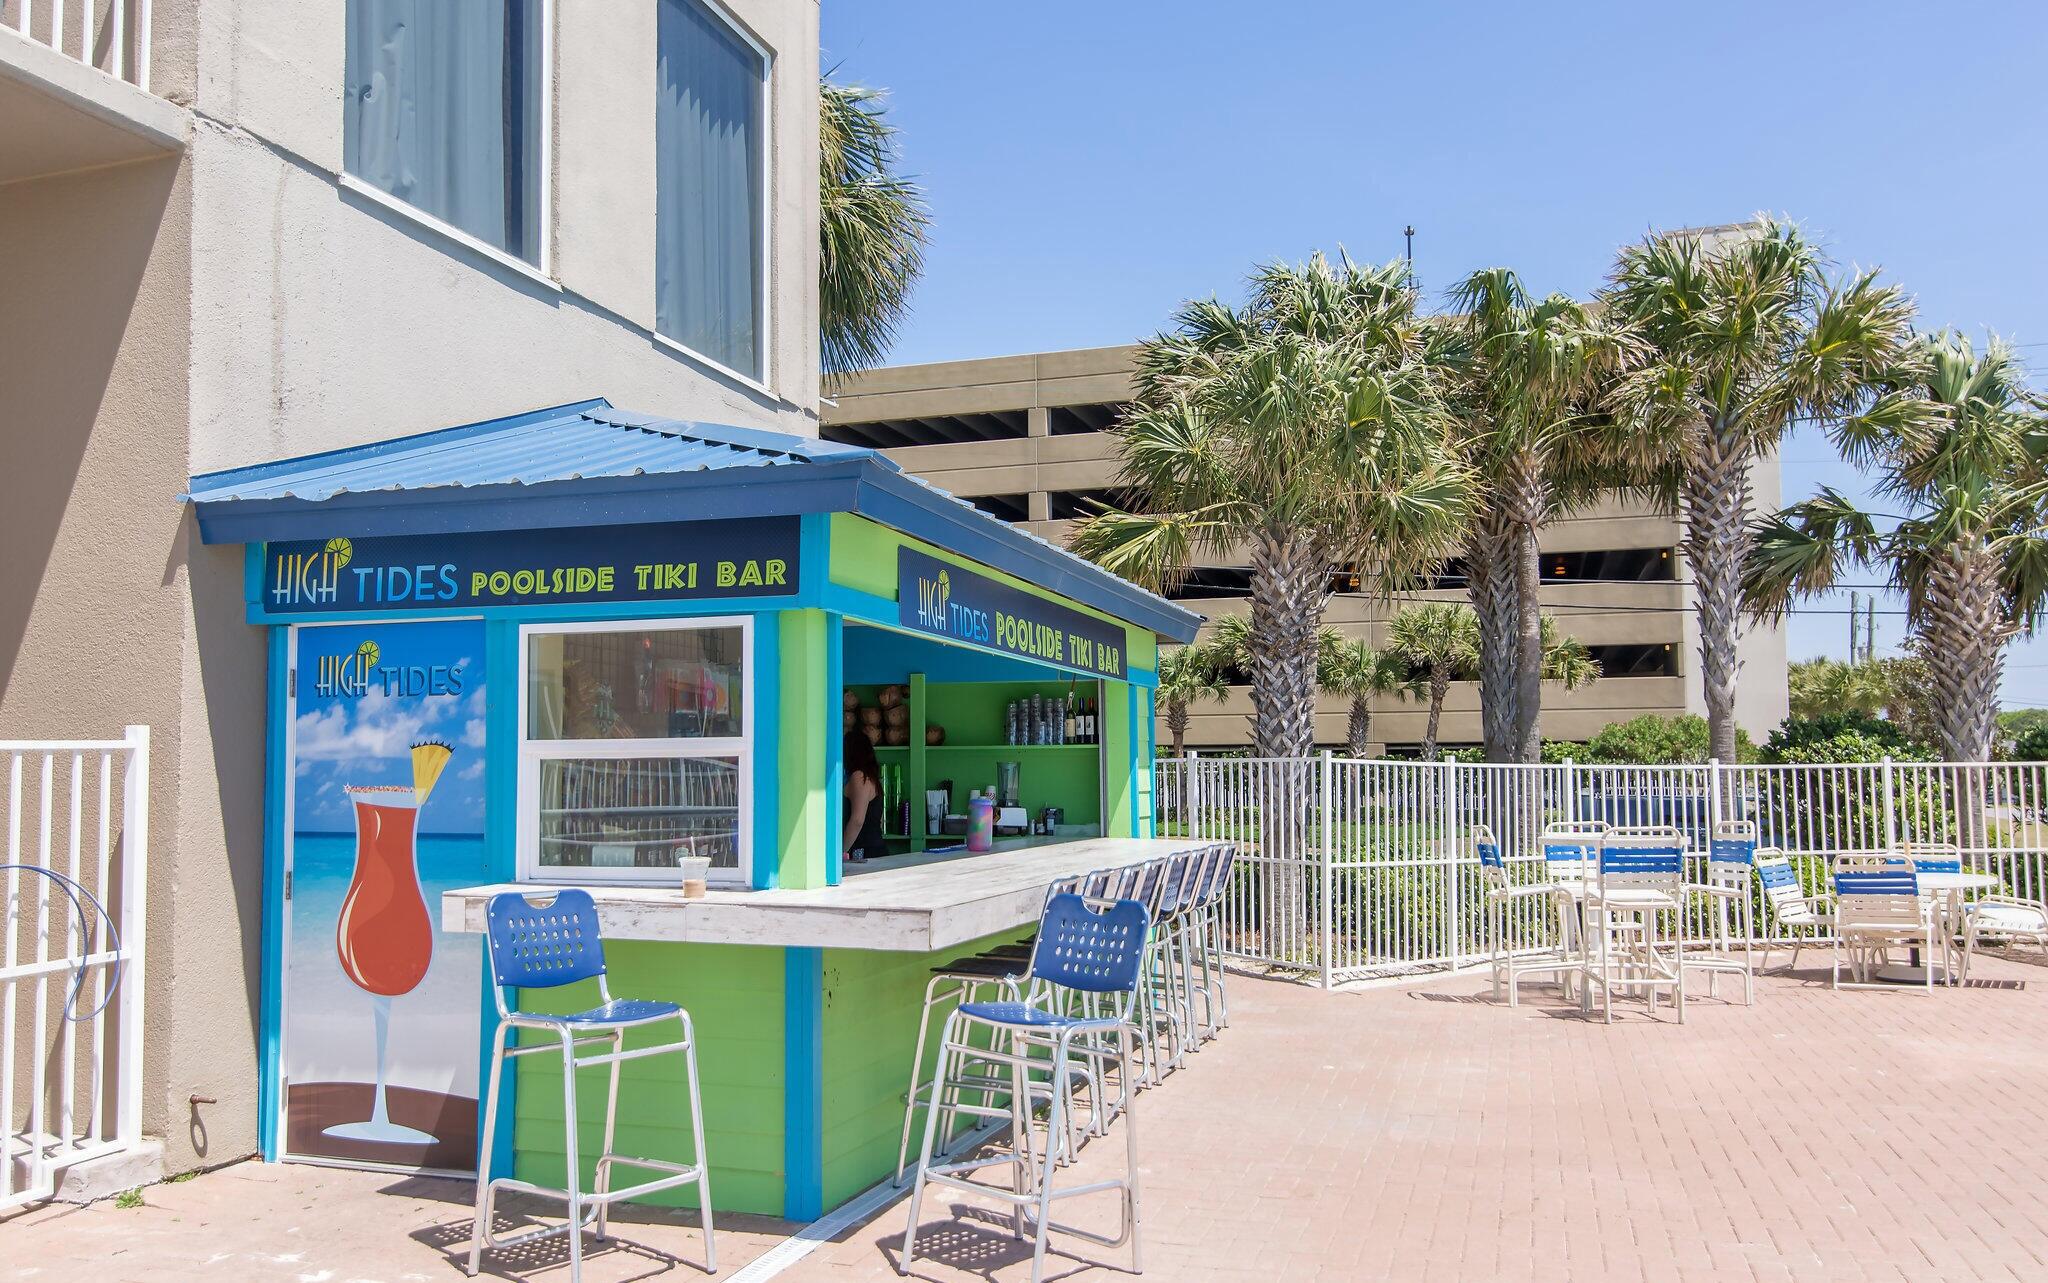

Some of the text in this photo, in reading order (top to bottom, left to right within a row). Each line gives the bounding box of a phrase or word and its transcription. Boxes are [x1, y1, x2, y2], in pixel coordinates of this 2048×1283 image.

[272, 552, 787, 604] HIGH TIDES POOLSIDE TIKI BAR
[918, 576, 1120, 676] HIGH TIDES POOLSIDE TIKI BAR
[315, 654, 464, 698] HIGH TIDES
